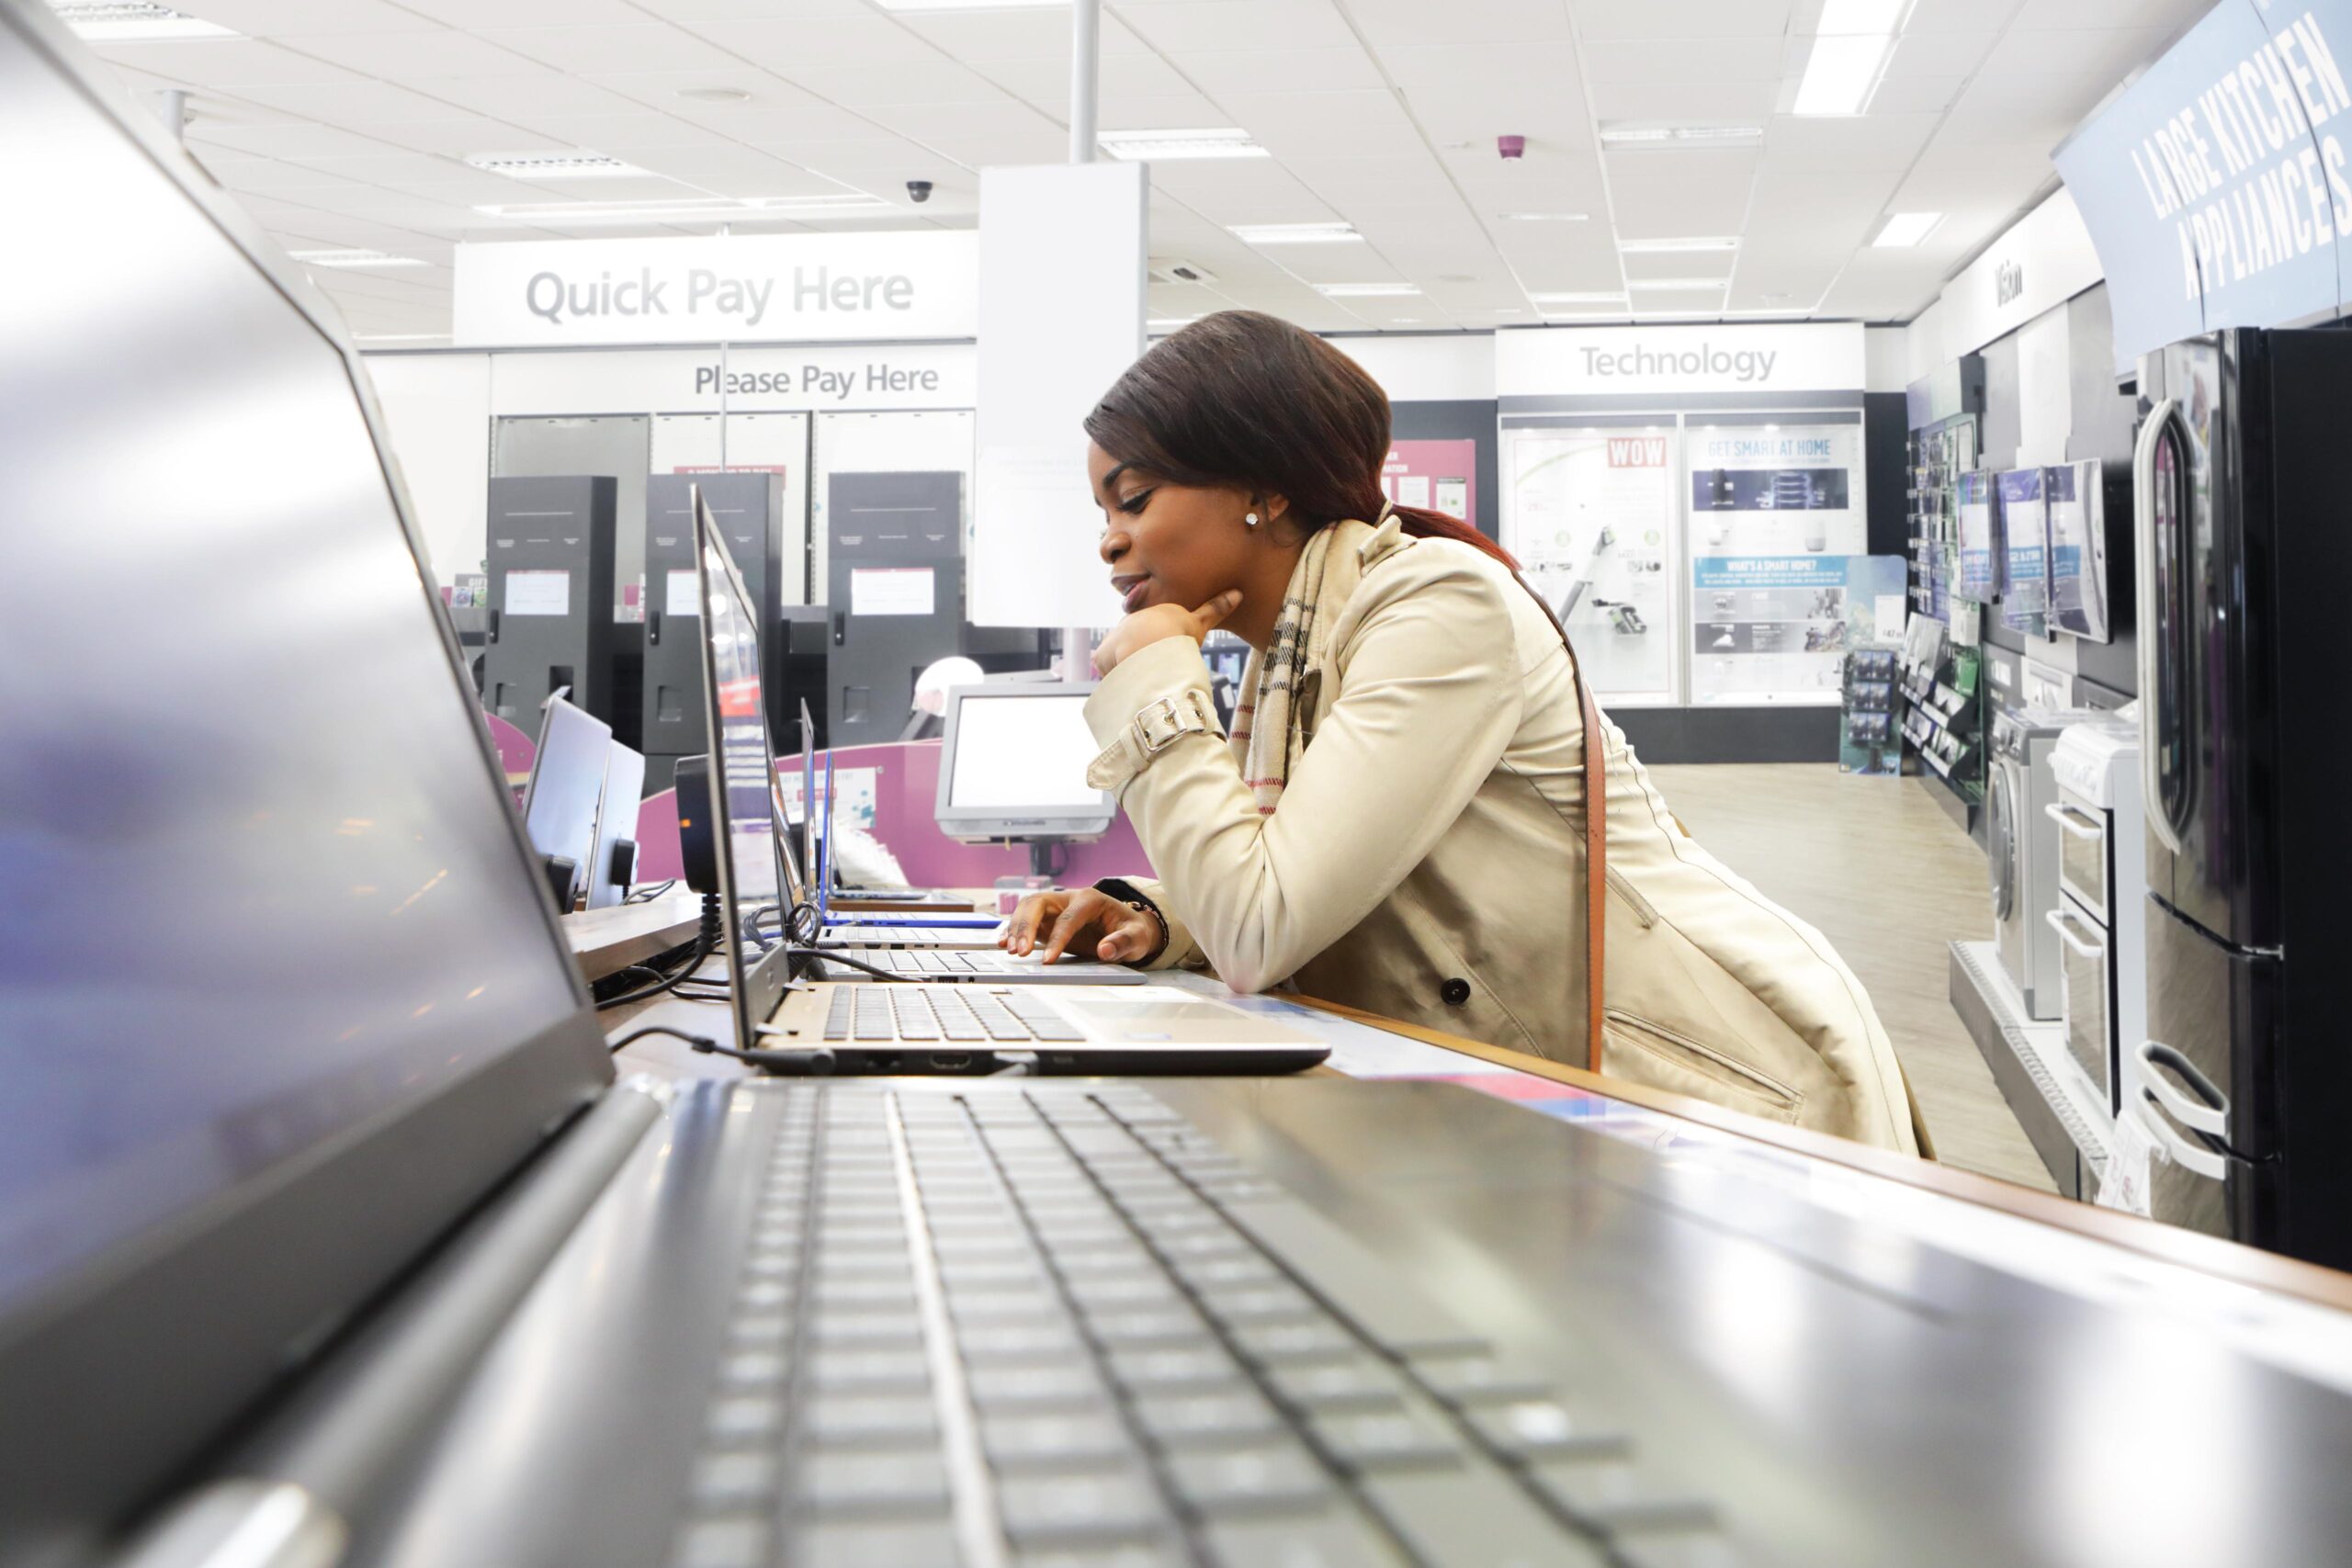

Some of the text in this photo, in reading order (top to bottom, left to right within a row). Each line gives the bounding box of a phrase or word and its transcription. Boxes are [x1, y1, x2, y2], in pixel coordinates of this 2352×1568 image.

[2132, 11, 2352, 220] LARGE KITCHEN
[2177, 135, 2352, 301] APPLIANCES
[526, 265, 914, 326] Quick Pay Here
[695, 363, 939, 399] Please Pay Here
[1579, 343, 1777, 382] Technology
[1610, 440, 1664, 466] WOW
[1709, 439, 1831, 457] GET SMART AT HOME
[1758, 560, 1763, 571] A
[1764, 559, 1789, 571] SMART
[1791, 559, 1816, 571] HOME?
